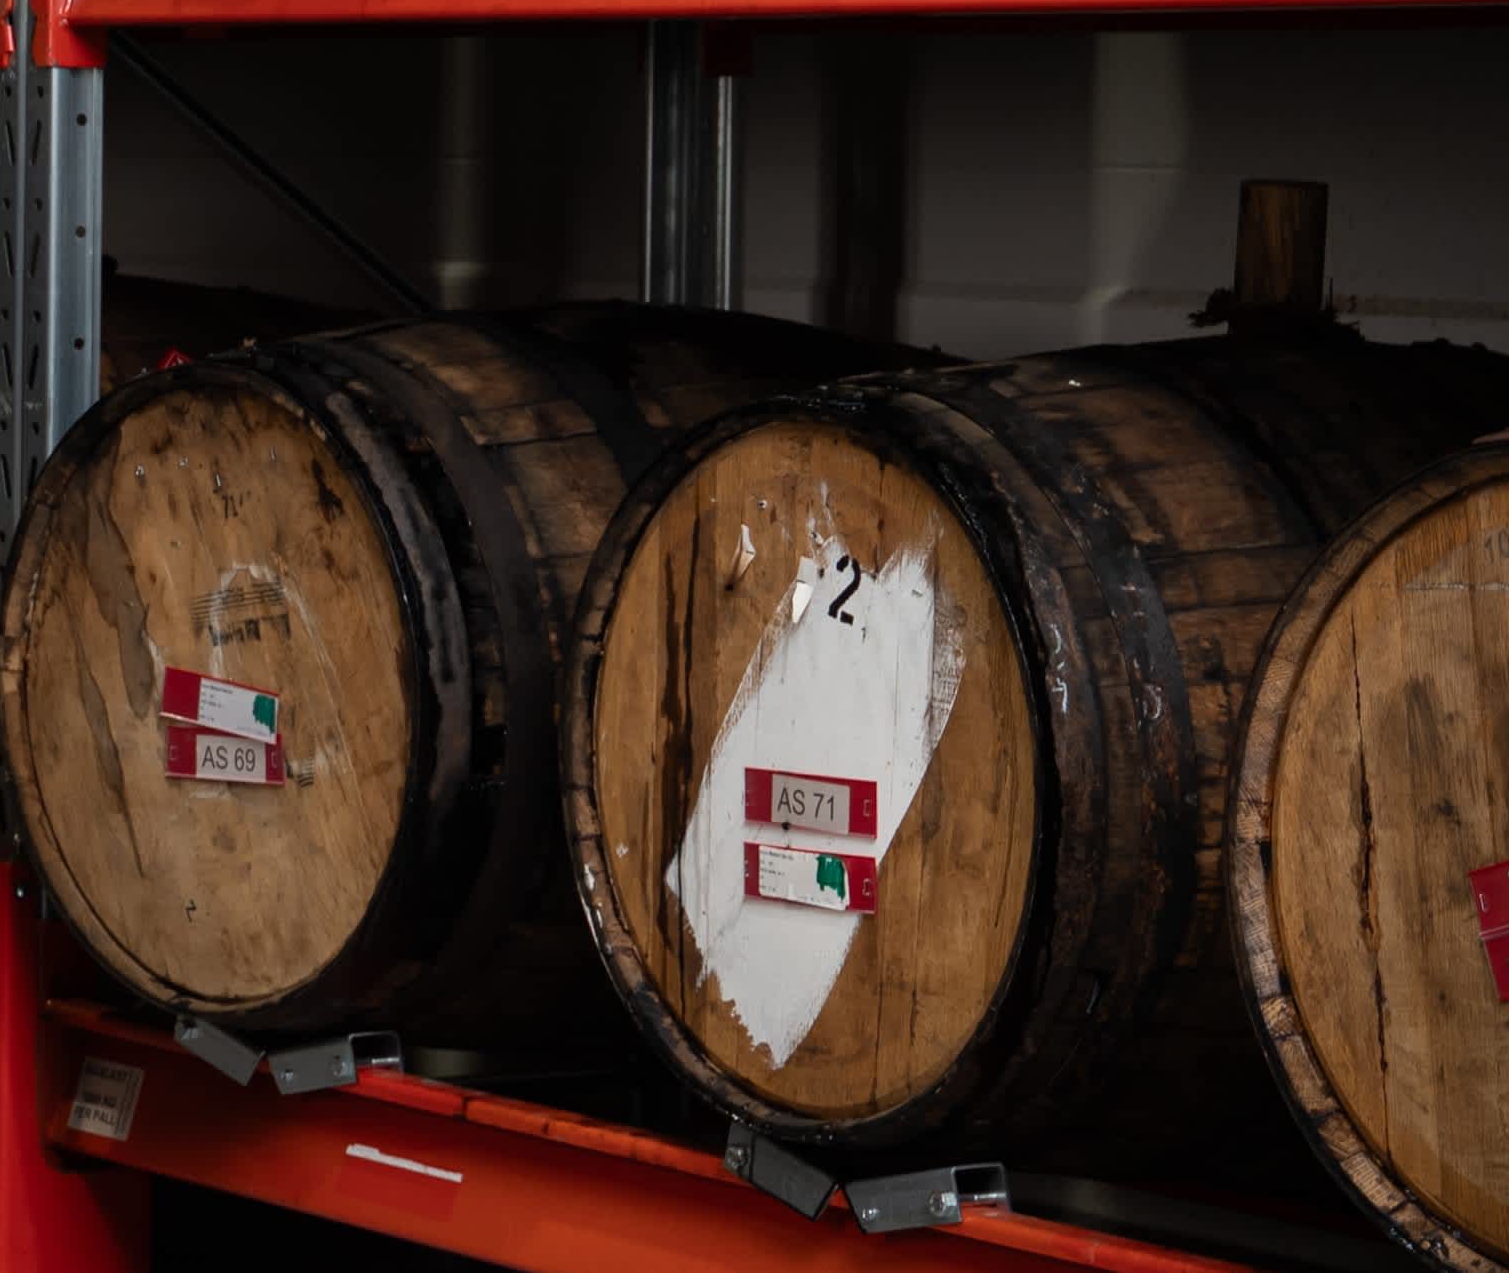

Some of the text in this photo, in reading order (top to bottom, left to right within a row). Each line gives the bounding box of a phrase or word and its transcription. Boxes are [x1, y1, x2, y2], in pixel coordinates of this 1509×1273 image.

[827, 554, 862, 627] 2
[201, 744, 257, 773] AS 69
[777, 785, 835, 822] AS 71
